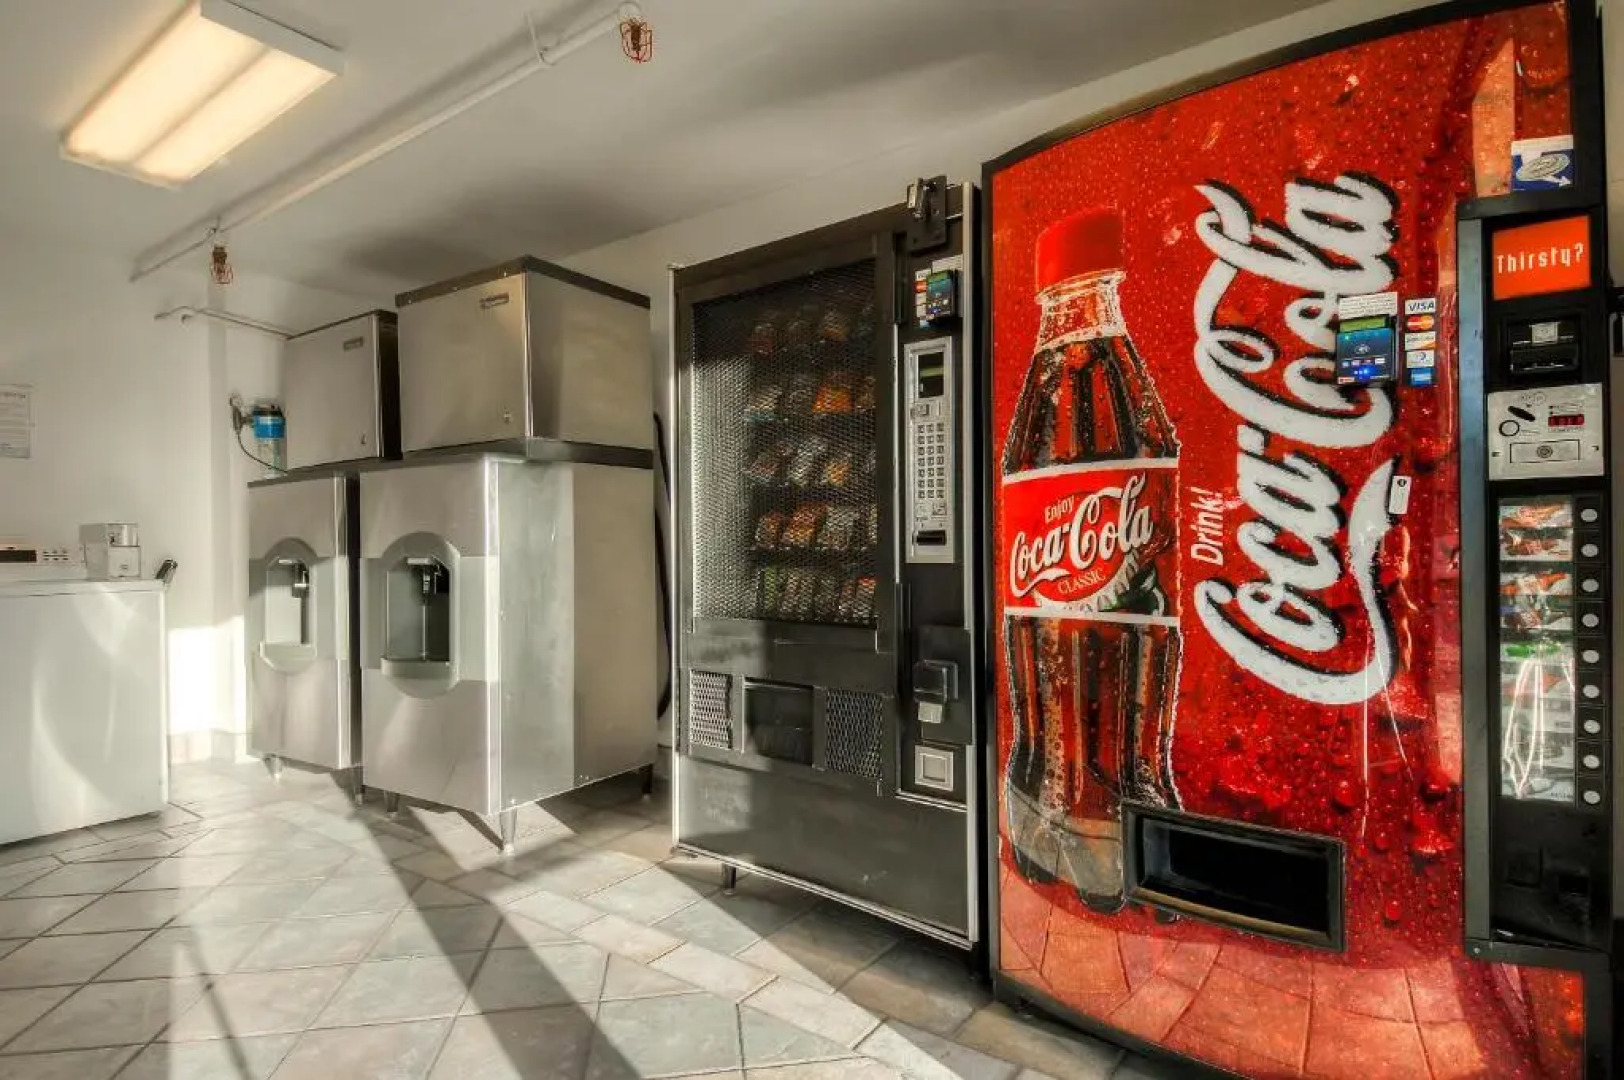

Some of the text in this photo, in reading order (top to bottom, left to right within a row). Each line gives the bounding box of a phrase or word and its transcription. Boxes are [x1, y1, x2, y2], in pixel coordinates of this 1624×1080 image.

[1497, 242, 1584, 274] Thirsty?
[1408, 301, 1435, 312] VISA
[1044, 495, 1075, 524] Enjoy
[1009, 471, 1153, 598] Coca-Cola
[1190, 485, 1223, 567] Drink!
[1057, 567, 1106, 594] CLASSIC
